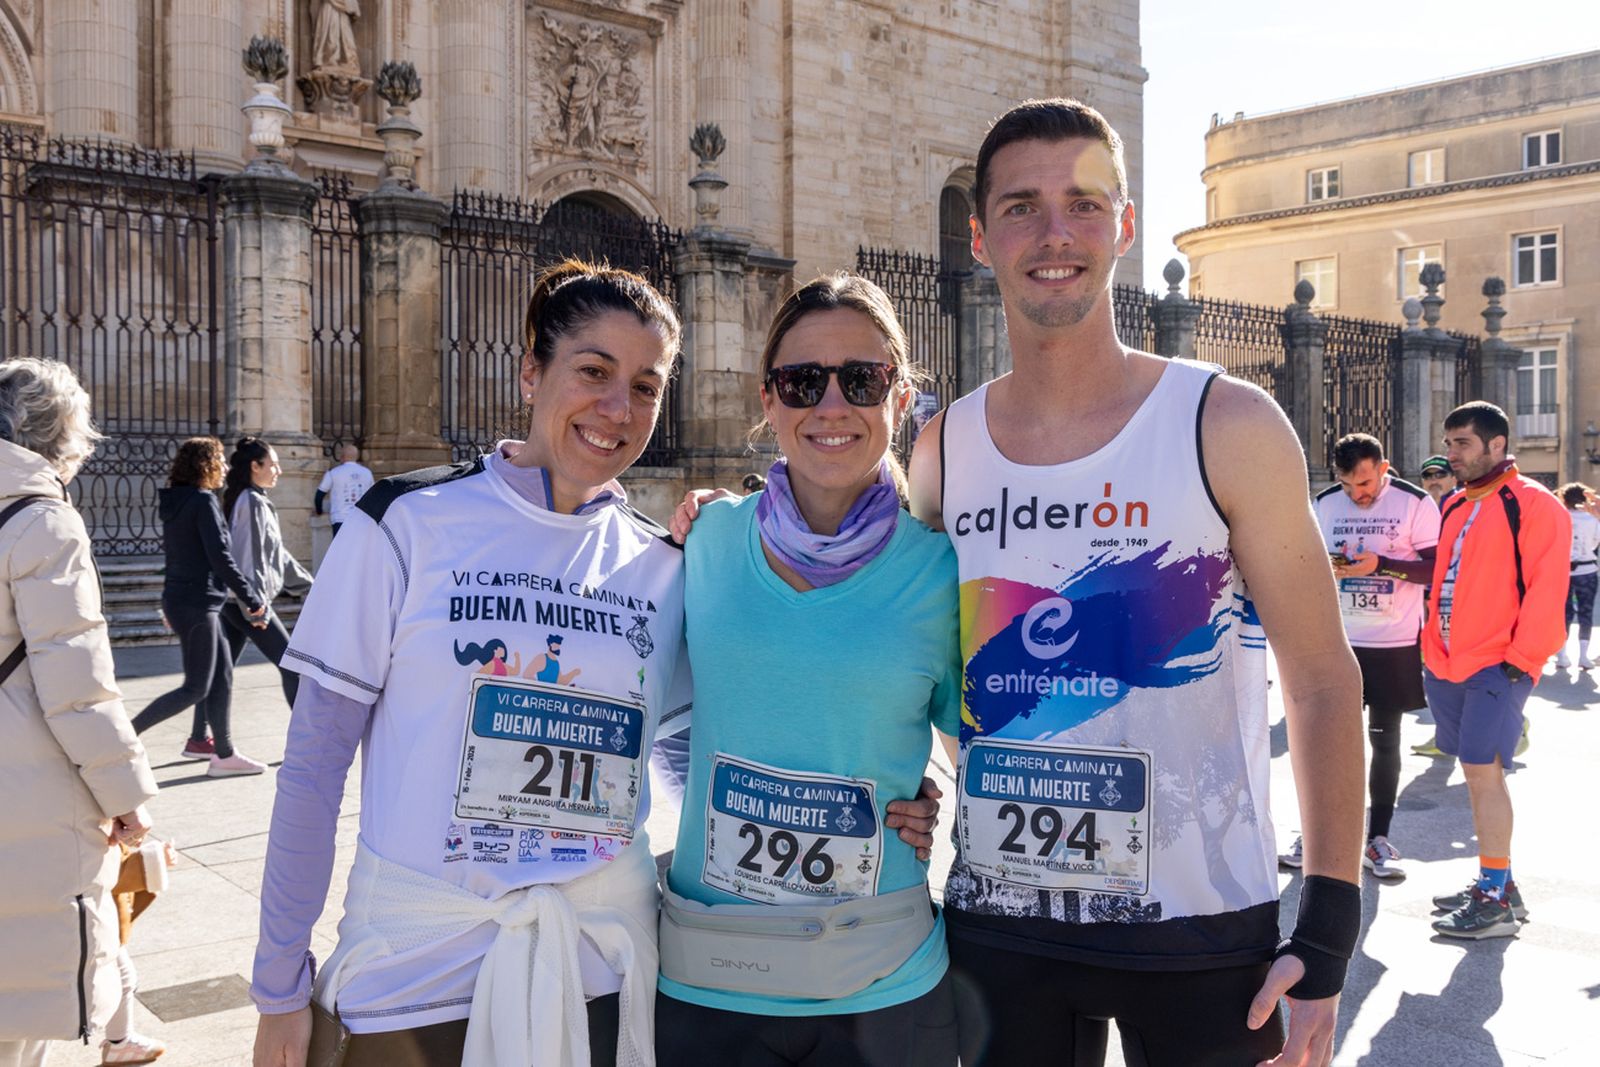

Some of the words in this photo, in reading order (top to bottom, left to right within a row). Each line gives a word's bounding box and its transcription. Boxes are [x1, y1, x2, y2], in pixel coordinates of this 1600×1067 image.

[955, 482, 1149, 549] calderón
[1333, 526, 1354, 535] BUENA
[1356, 526, 1385, 535] MUERTE
[1090, 537, 1119, 548] desde
[1126, 538, 1148, 548] 1949
[452, 570, 470, 586] VI
[476, 571, 564, 594] CARRERA
[569, 582, 657, 613] CAMINATA
[1351, 593, 1379, 608] 134
[450, 596, 527, 623] BUENA
[536, 600, 623, 636] MUERTE
[985, 667, 1119, 697] entrénate
[497, 692, 510, 704] VI
[513, 694, 569, 714] CARRERA
[573, 703, 630, 725] CAMINATA
[492, 712, 541, 737] BUENA
[546, 719, 603, 746] MUERTE
[520, 746, 595, 801] 211
[984, 754, 994, 765] VI
[997, 754, 1051, 770] CARRERA
[1054, 759, 1123, 777] CAMINATA
[729, 771, 740, 782] VI
[741, 773, 790, 798] CARRERA
[793, 787, 858, 805] CAMINATA
[981, 772, 1025, 796] BUENA
[1029, 777, 1091, 802] MUERTE
[498, 794, 531, 805] MIRYAM
[532, 798, 568, 809] ANGUITA
[568, 801, 610, 815] HERNÁNDEZ
[726, 789, 764, 819] BUENA
[768, 802, 828, 828] MUERTE
[473, 841, 510, 851] BYD
[519, 839, 541, 850] CUA
[997, 803, 1101, 861] 294
[518, 848, 533, 857] LIA
[737, 823, 835, 885] 296
[1002, 854, 1031, 866] MANUEL
[1033, 859, 1071, 870] MARTÍNEZ
[1072, 863, 1094, 871] VICO
[734, 868, 761, 883] LOURDES
[763, 878, 799, 891] CARRILLO
[799, 883, 835, 894] VÁZQUEZ
[710, 957, 771, 973] DINYU
